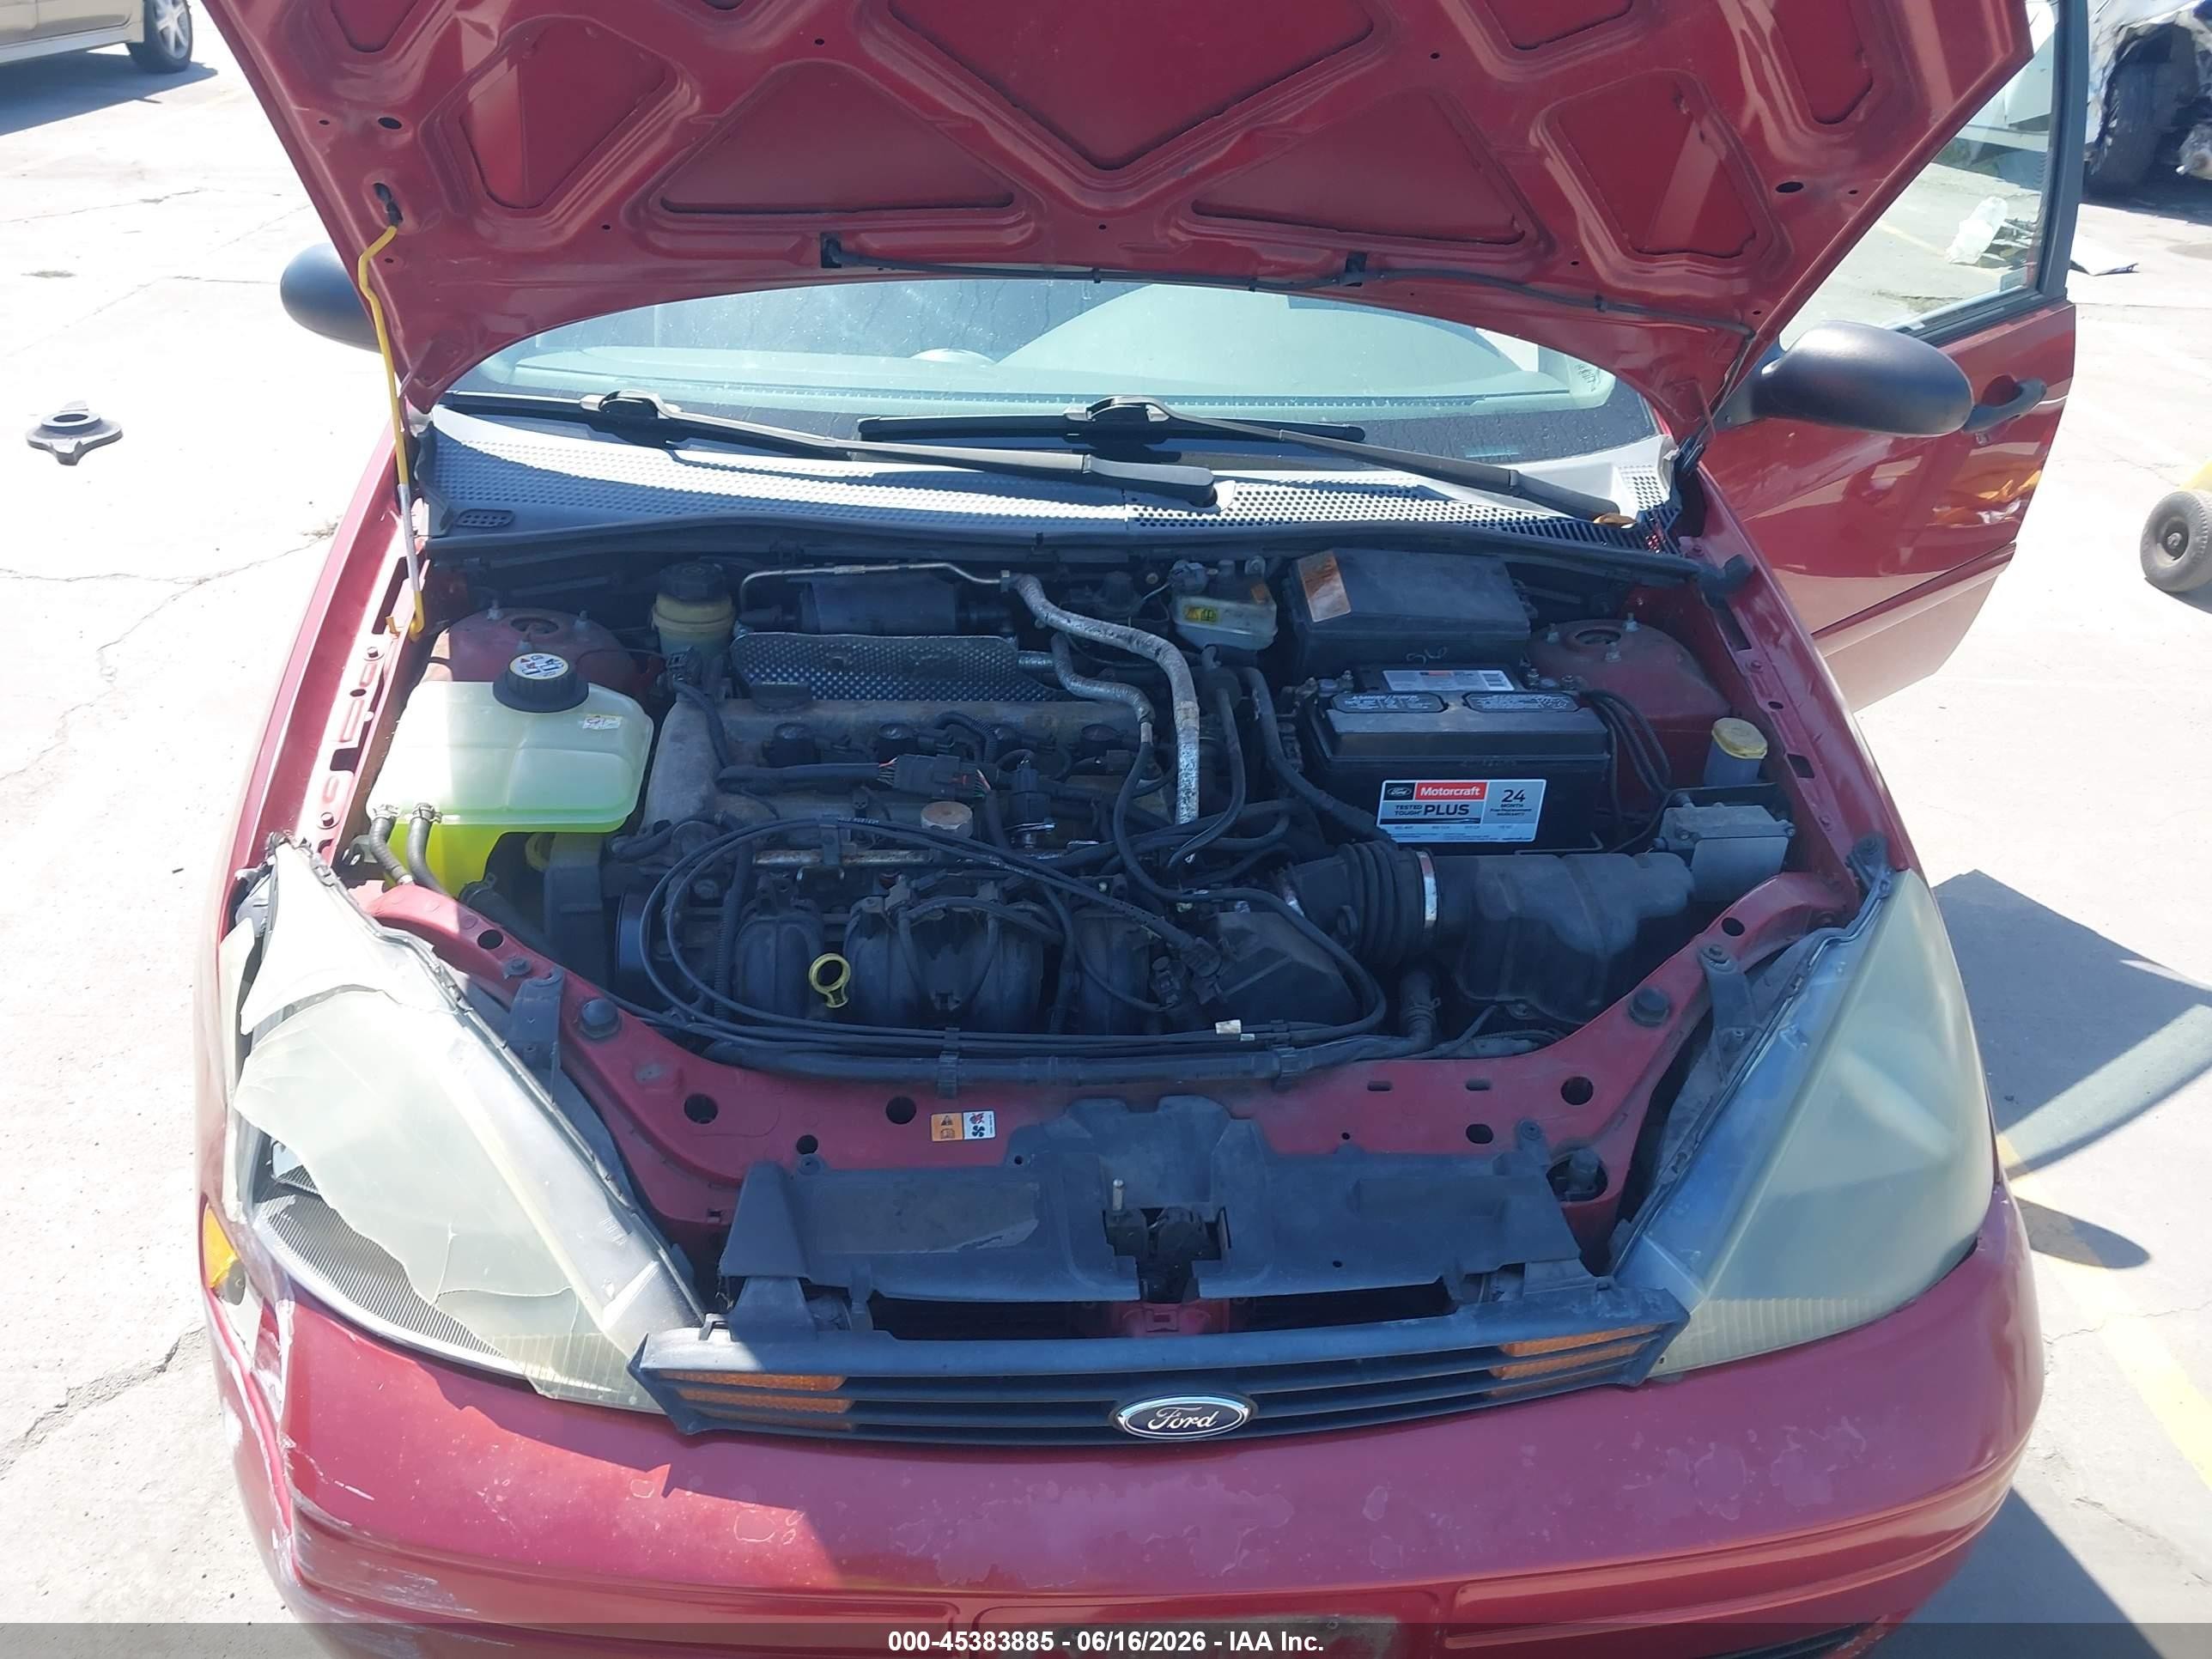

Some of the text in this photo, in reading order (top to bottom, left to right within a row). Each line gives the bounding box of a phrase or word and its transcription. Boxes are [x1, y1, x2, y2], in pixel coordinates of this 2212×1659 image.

[1420, 786, 1481, 797] Motorcraft
[1501, 788, 1526, 802] 24
[1424, 804, 1470, 816] PLUS
[1147, 1407, 1219, 1430] Ford
